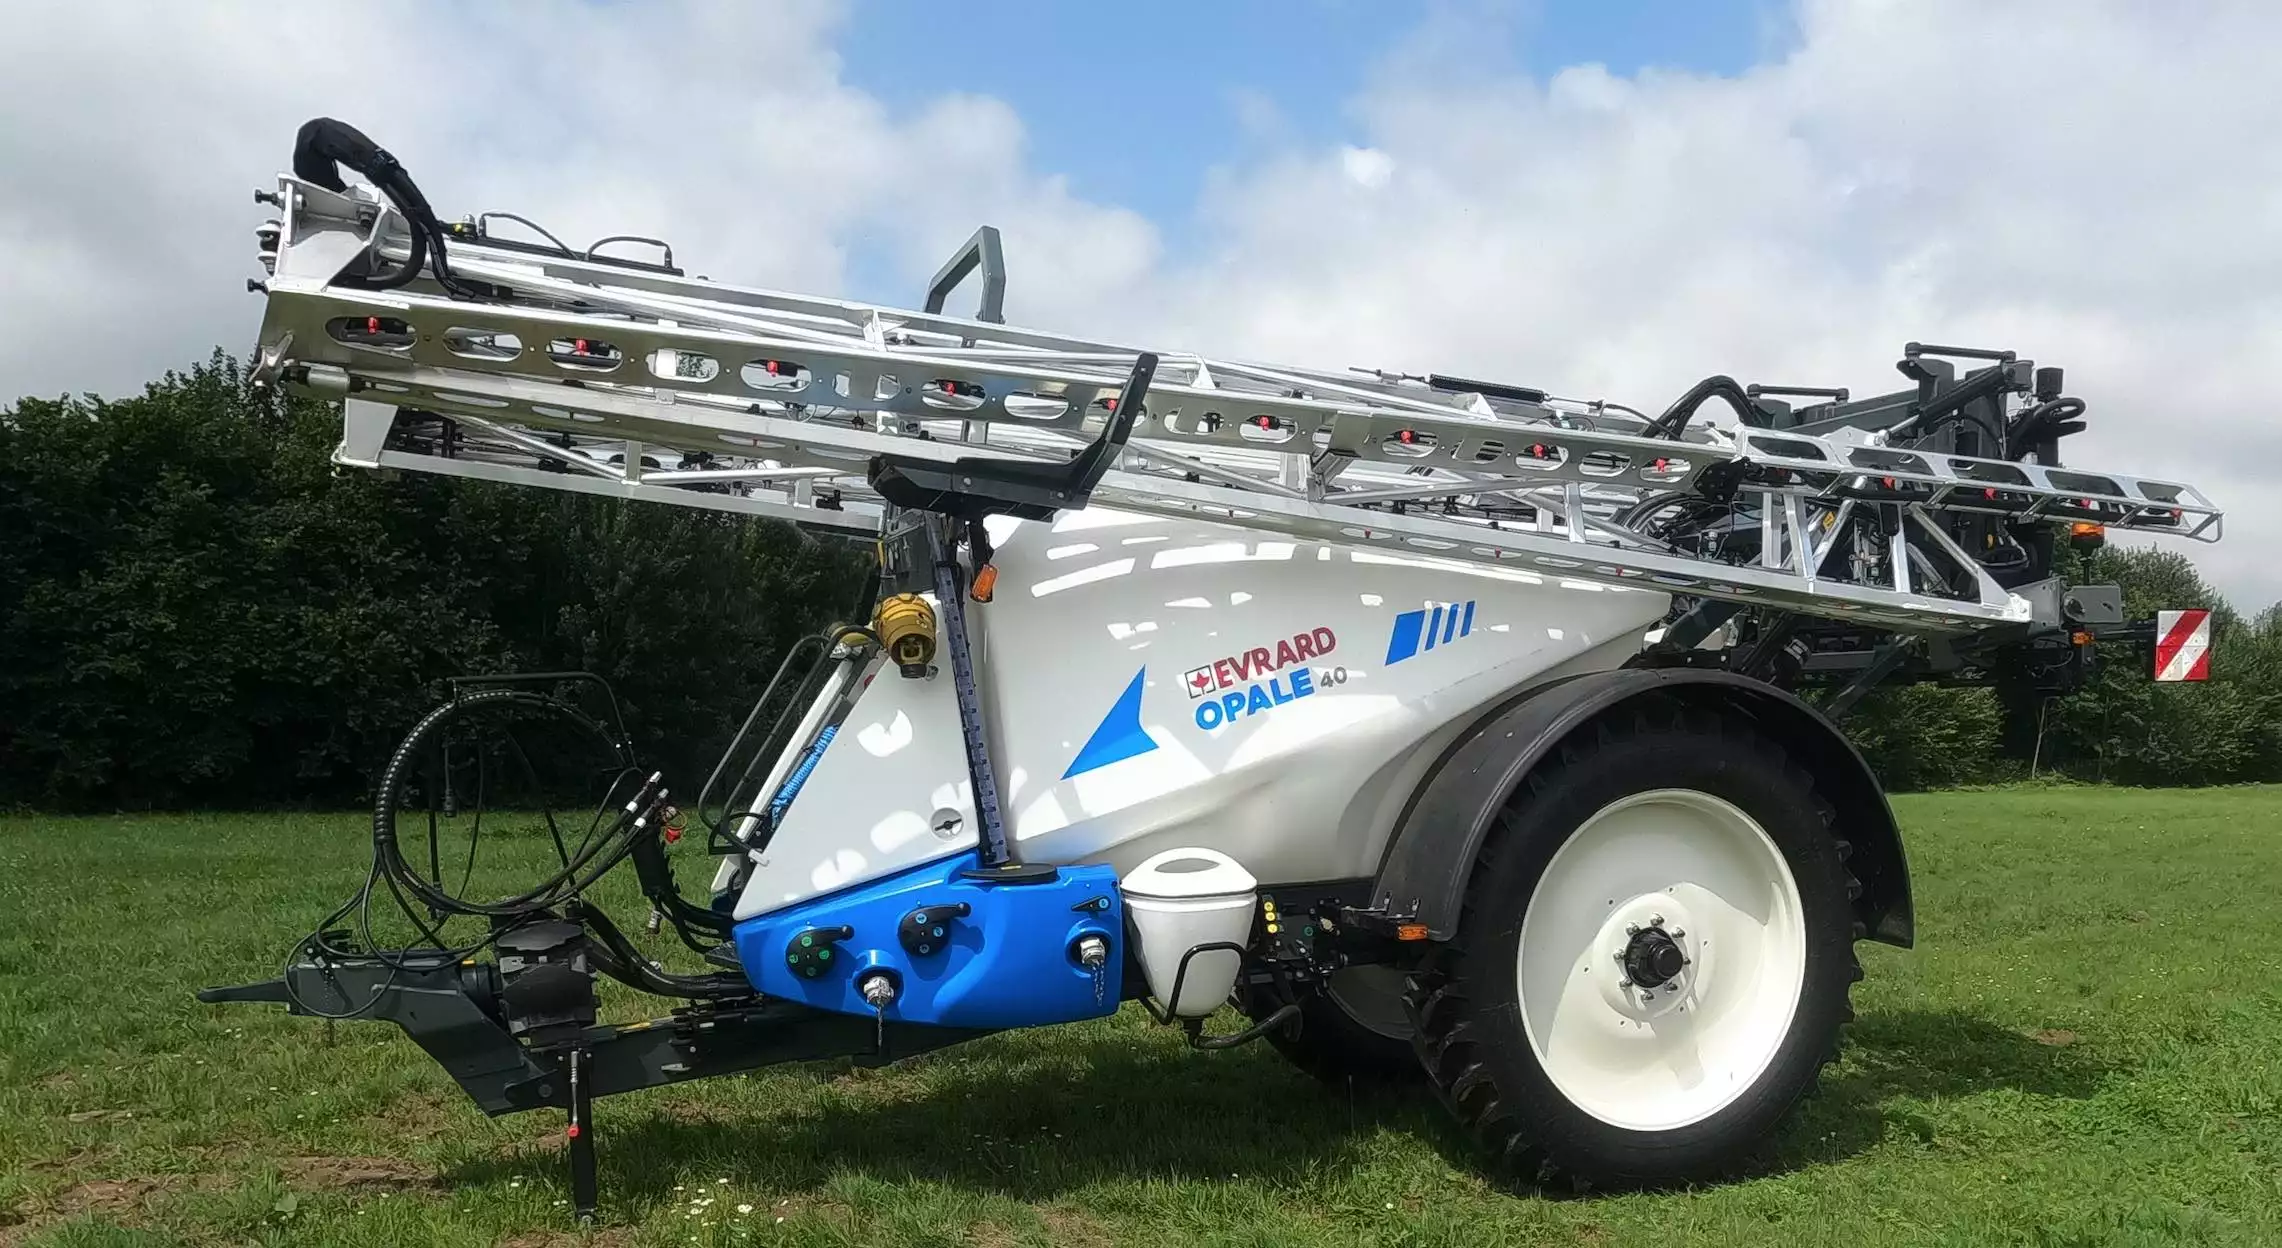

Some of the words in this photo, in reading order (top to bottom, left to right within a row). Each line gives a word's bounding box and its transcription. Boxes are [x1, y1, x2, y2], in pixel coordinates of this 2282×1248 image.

[1213, 626, 1336, 689] EVRARD
[1195, 667, 1315, 730] OPALE
[1320, 666, 1348, 688] 40
